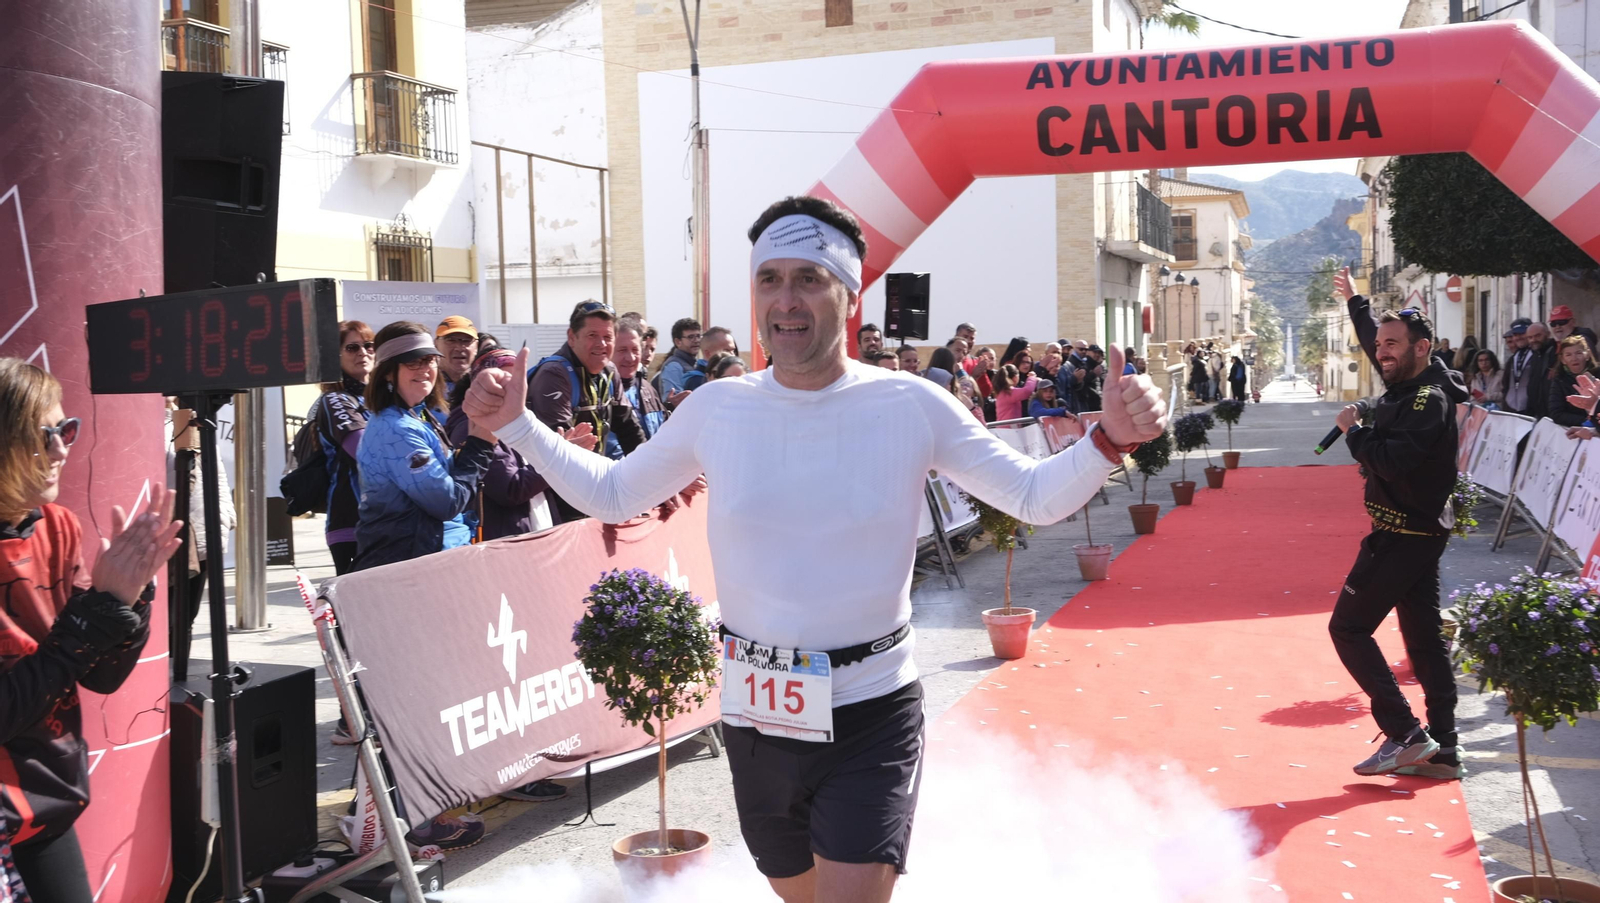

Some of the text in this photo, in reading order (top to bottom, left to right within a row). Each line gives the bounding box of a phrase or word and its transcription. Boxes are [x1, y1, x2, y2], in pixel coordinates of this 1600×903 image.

[1026, 37, 1395, 90] AYUNTAMIENTO
[1036, 86, 1383, 157] CANTORIA
[353, 292, 467, 304] CONSTRUYAMOS UN FUTURO
[379, 305, 442, 316] SIN ADICCIONES
[129, 291, 310, 382] 3:18:20
[736, 652, 746, 664] LA
[440, 660, 596, 757] TEAMERGY
[745, 672, 805, 715] 115
